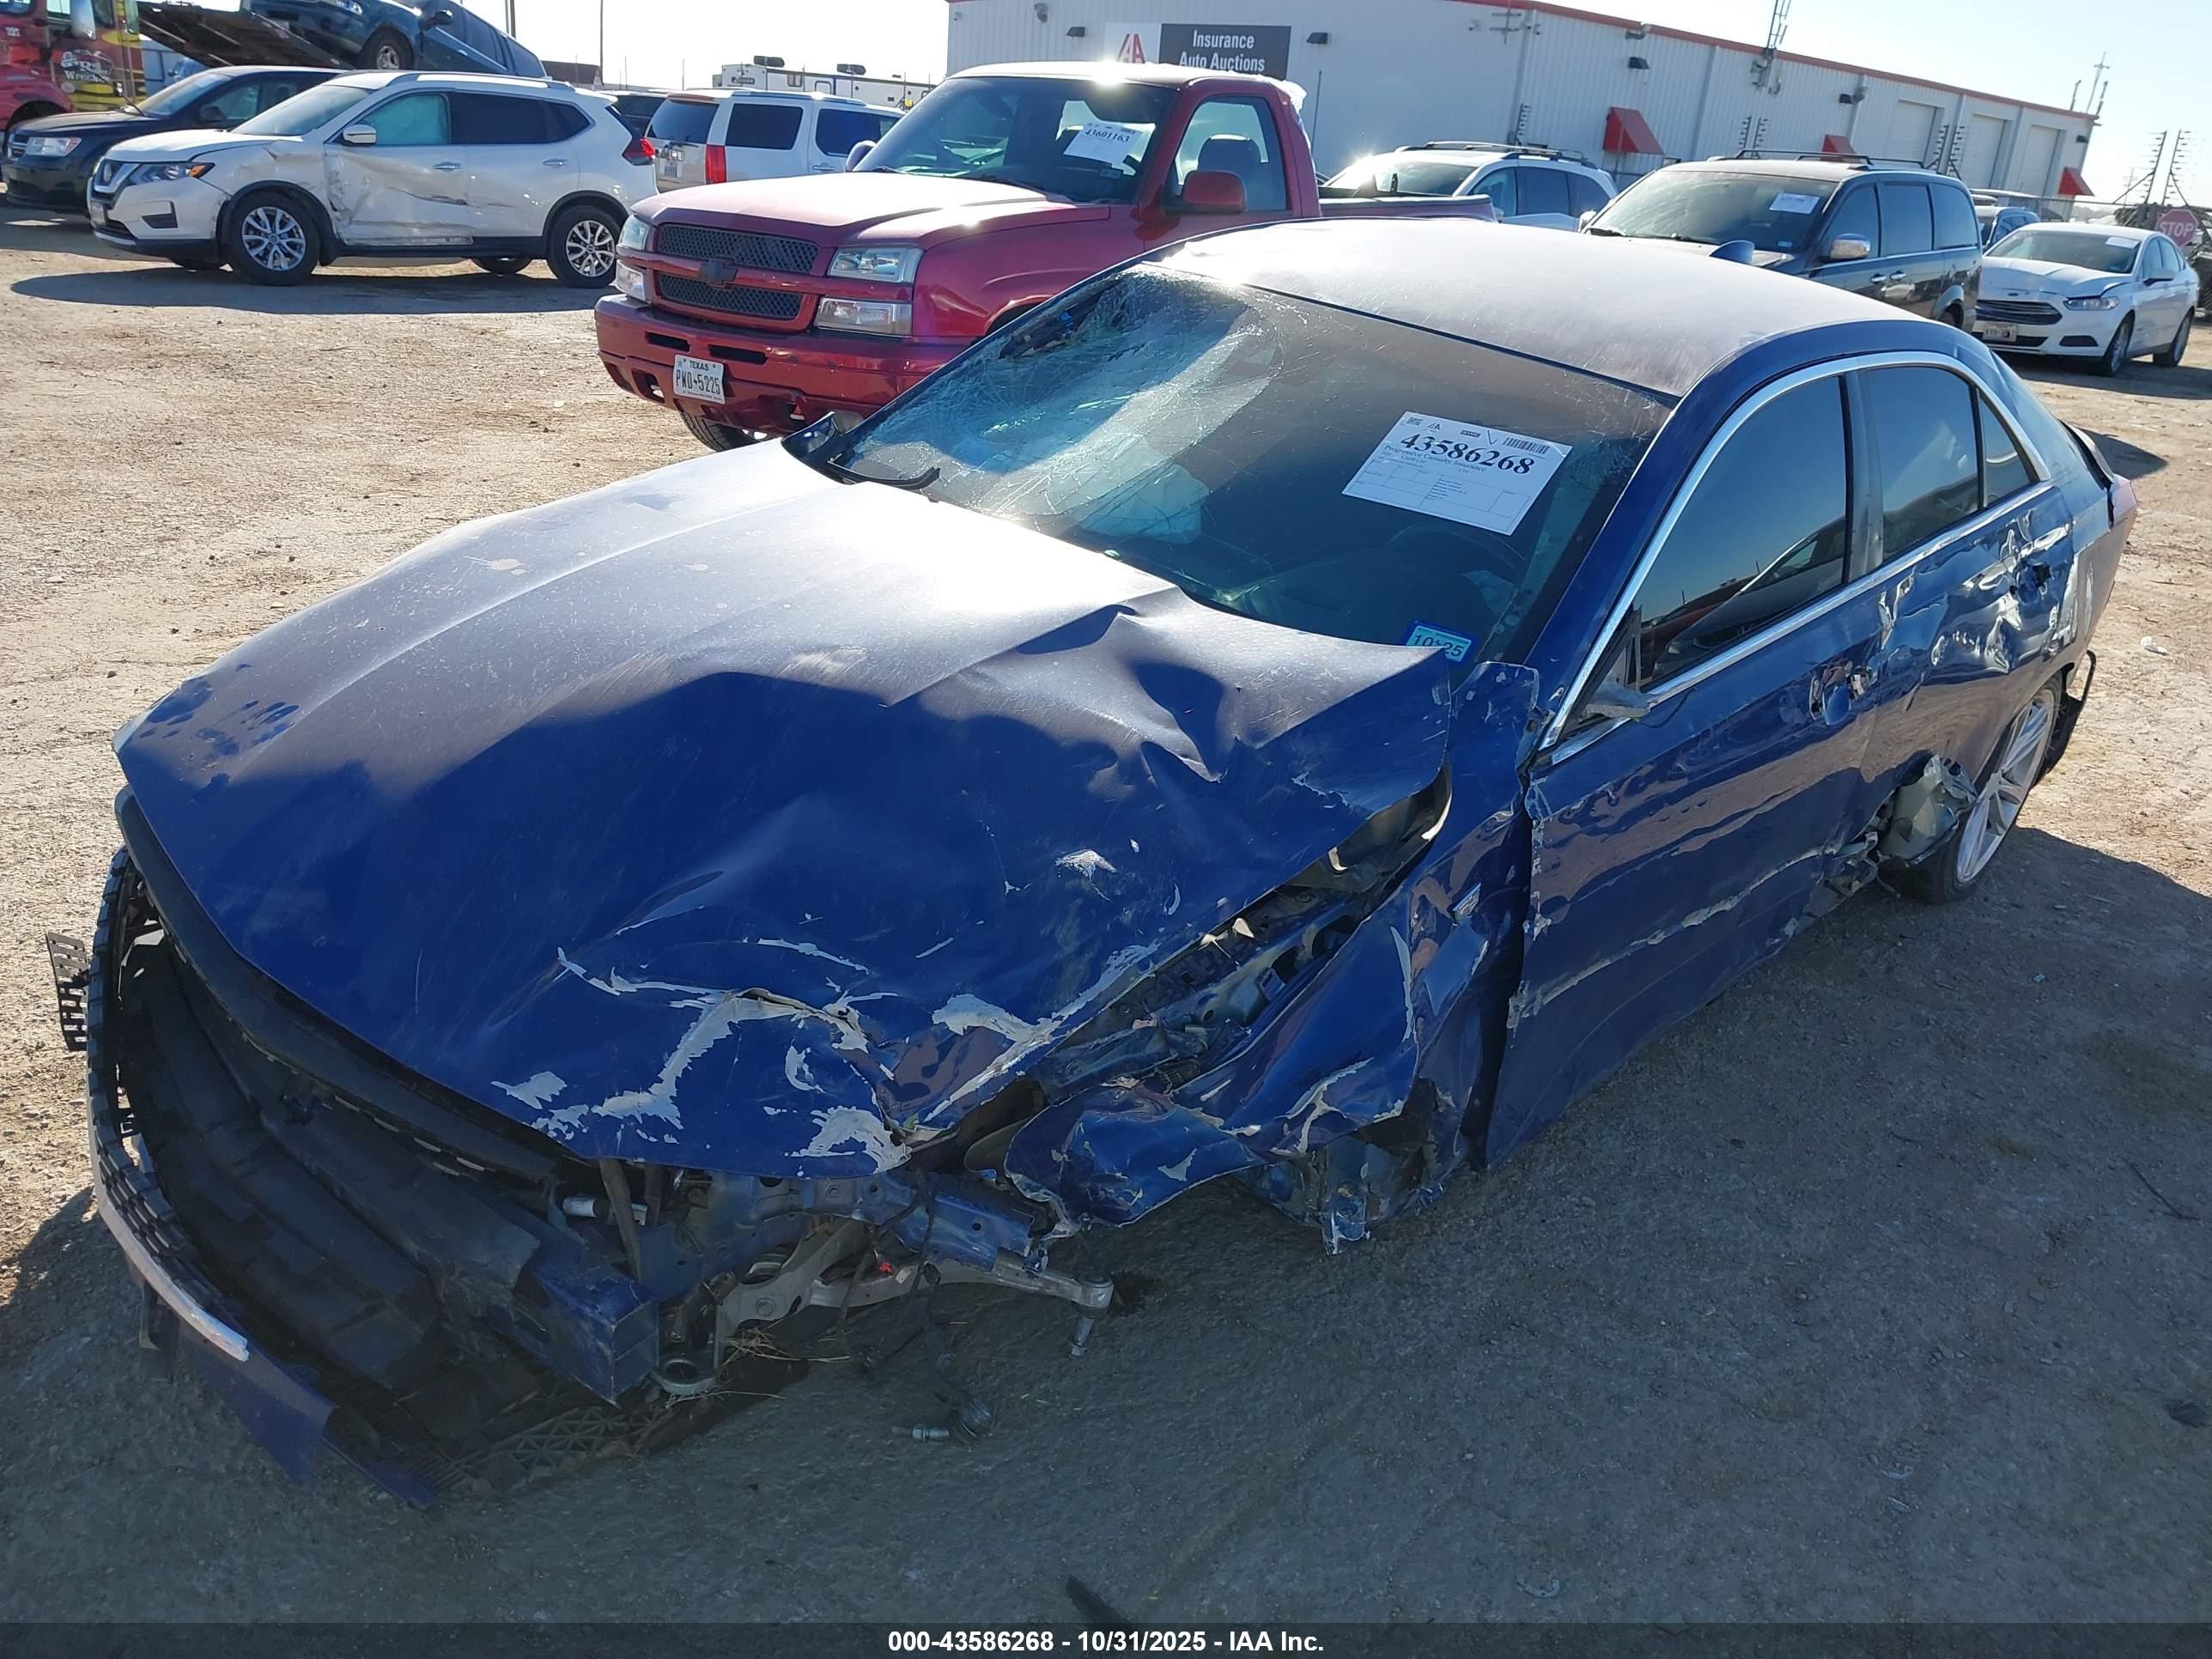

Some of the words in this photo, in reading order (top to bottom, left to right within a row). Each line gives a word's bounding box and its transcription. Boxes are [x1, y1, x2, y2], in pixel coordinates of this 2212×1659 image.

[1193, 29, 1255, 49] Insurance
[1179, 51, 1207, 68] Auto
[1210, 52, 1265, 72] Auctions
[1085, 129, 1131, 143] 43601163
[2160, 221, 2195, 238] STOP
[690, 361, 709, 372] TEXAS
[1384, 445, 1423, 458] Progressive
[1424, 453, 1450, 464] Casualty
[1454, 459, 1486, 472] Insurance
[1401, 434, 1534, 474] 43586268
